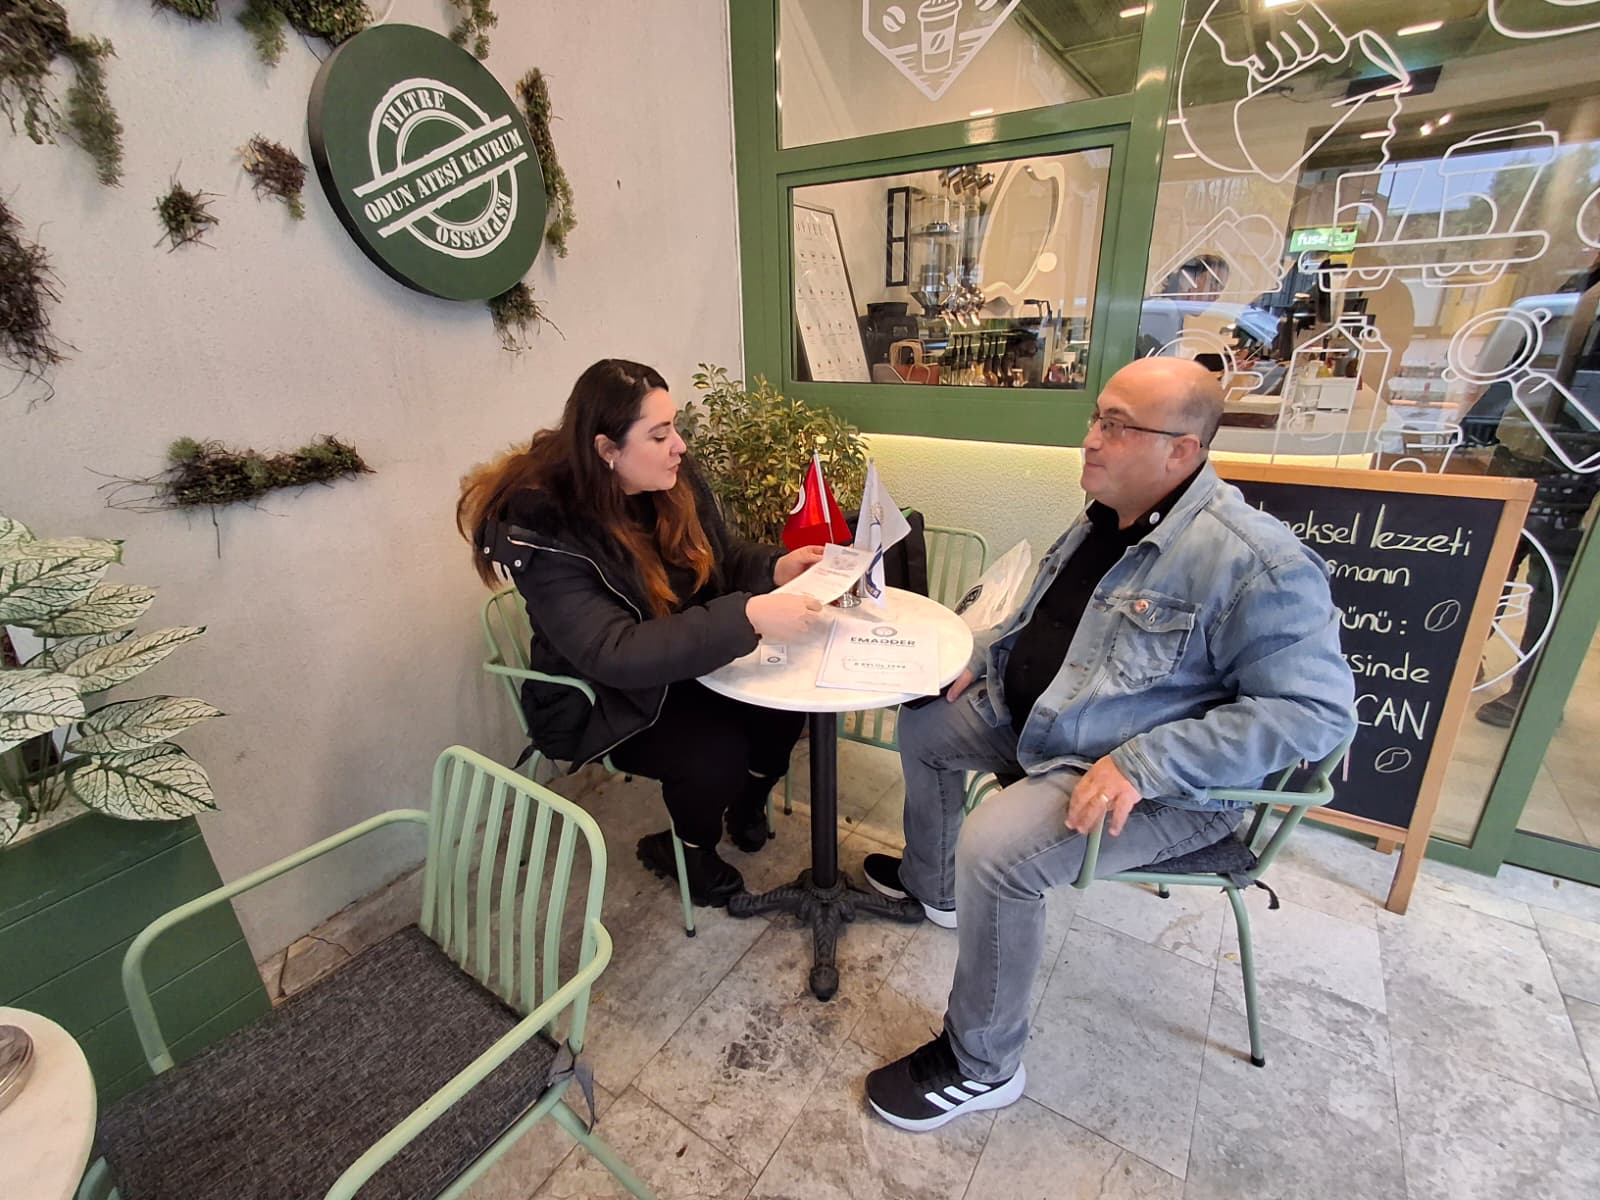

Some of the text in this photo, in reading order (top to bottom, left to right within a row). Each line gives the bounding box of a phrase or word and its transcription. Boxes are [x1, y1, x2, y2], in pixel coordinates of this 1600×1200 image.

[364, 128, 524, 223] ODUN ATEŞİ KAVRUM
[436, 192, 511, 248] ESPRESSO
[1297, 231, 1328, 247] fuse
[1369, 503, 1473, 556] lezzeti
[850, 636, 916, 646] EMADDER
[1341, 651, 1430, 683] sinde
